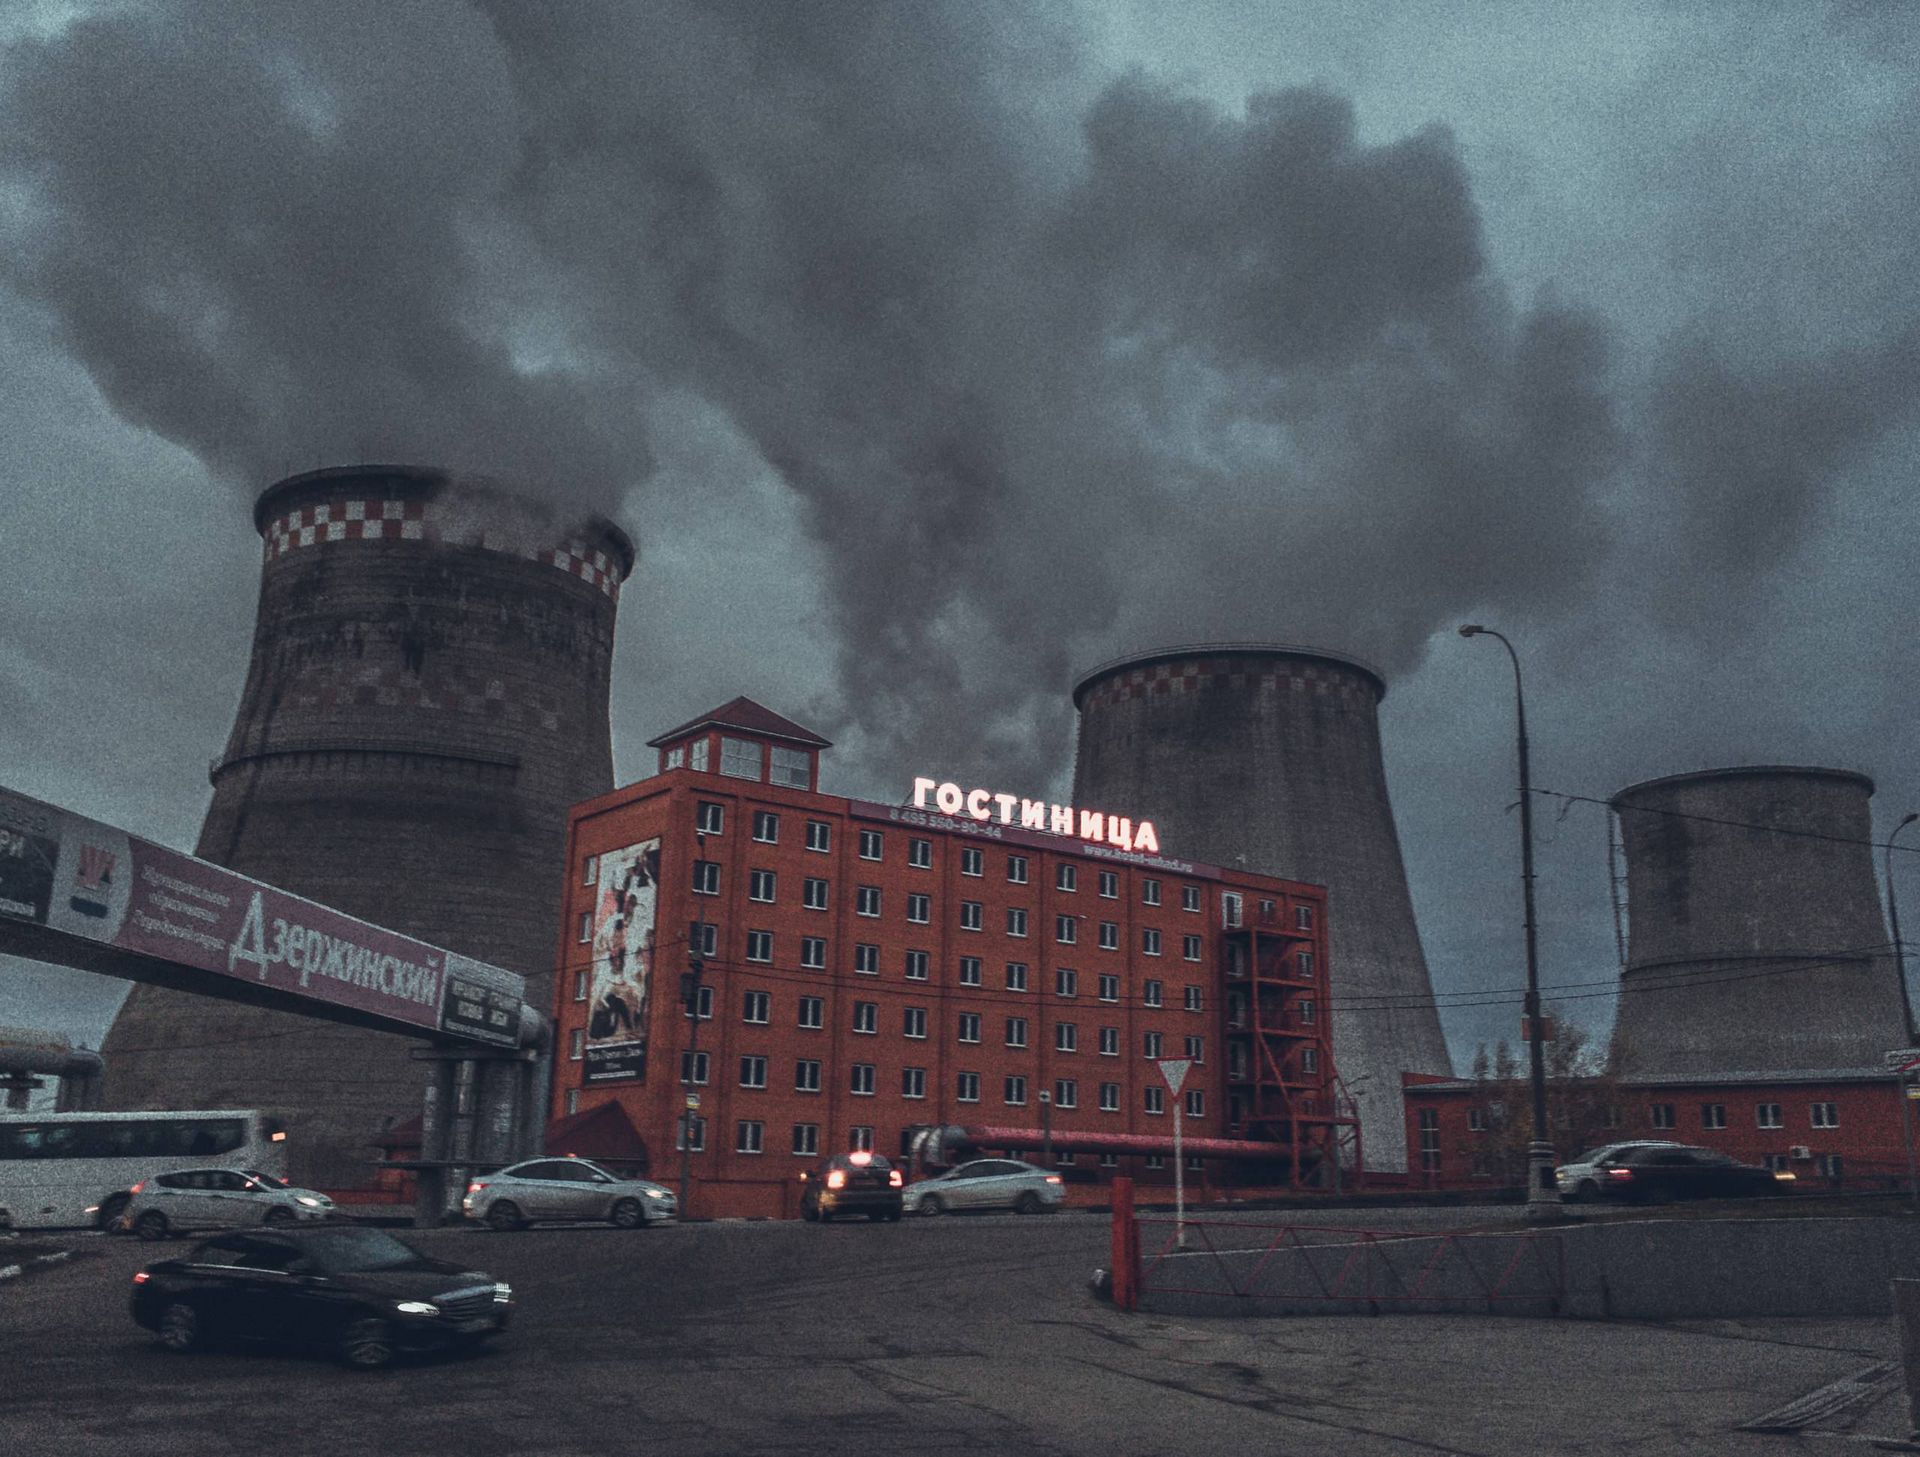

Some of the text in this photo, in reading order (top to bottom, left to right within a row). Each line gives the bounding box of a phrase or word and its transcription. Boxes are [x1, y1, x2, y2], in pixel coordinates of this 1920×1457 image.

[889, 809, 1003, 839] 8 495 550-90-44
[913, 776, 1159, 852] ГОСТИНИЦА
[228, 890, 438, 1007] Дзержинский
